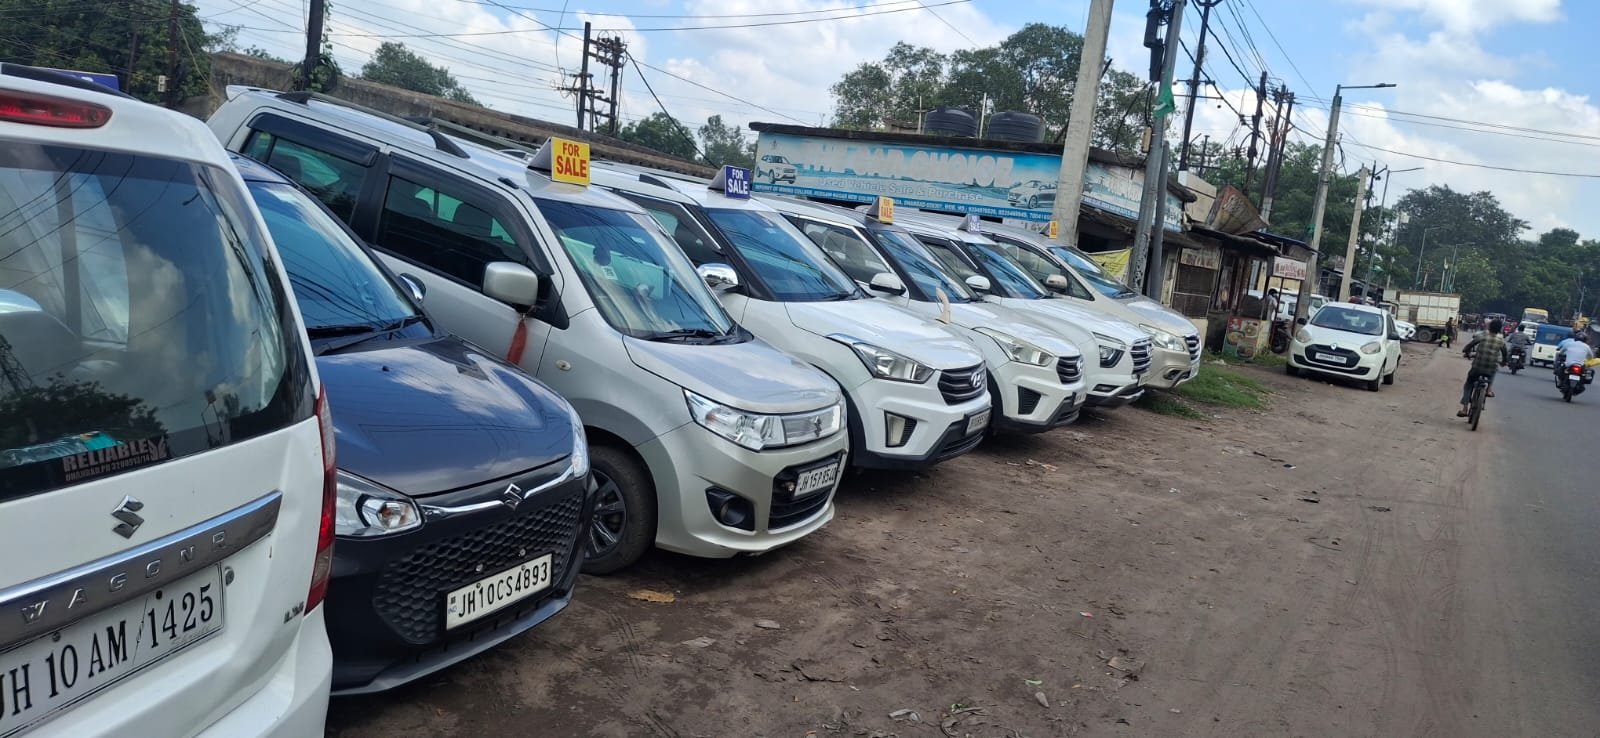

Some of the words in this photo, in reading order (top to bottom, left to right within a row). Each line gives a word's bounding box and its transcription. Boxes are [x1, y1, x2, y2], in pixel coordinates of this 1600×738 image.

[562, 142, 580, 157] FOR
[556, 155, 588, 178] SALE
[731, 168, 744, 180] FOR
[849, 142, 905, 178] CAR
[911, 149, 1015, 189] CHOICE
[727, 178, 749, 195] SALE
[819, 177, 846, 189] Used
[847, 180, 886, 192] Vehicle
[889, 183, 913, 195] Sale
[916, 187, 925, 196] &
[928, 187, 983, 201] Purchase
[62, 438, 149, 473] RELIABLE
[458, 561, 548, 618] JH10CS4893
[45, 644, 79, 699] 10
[88, 619, 128, 678] AM
[147, 583, 214, 649] 1425
